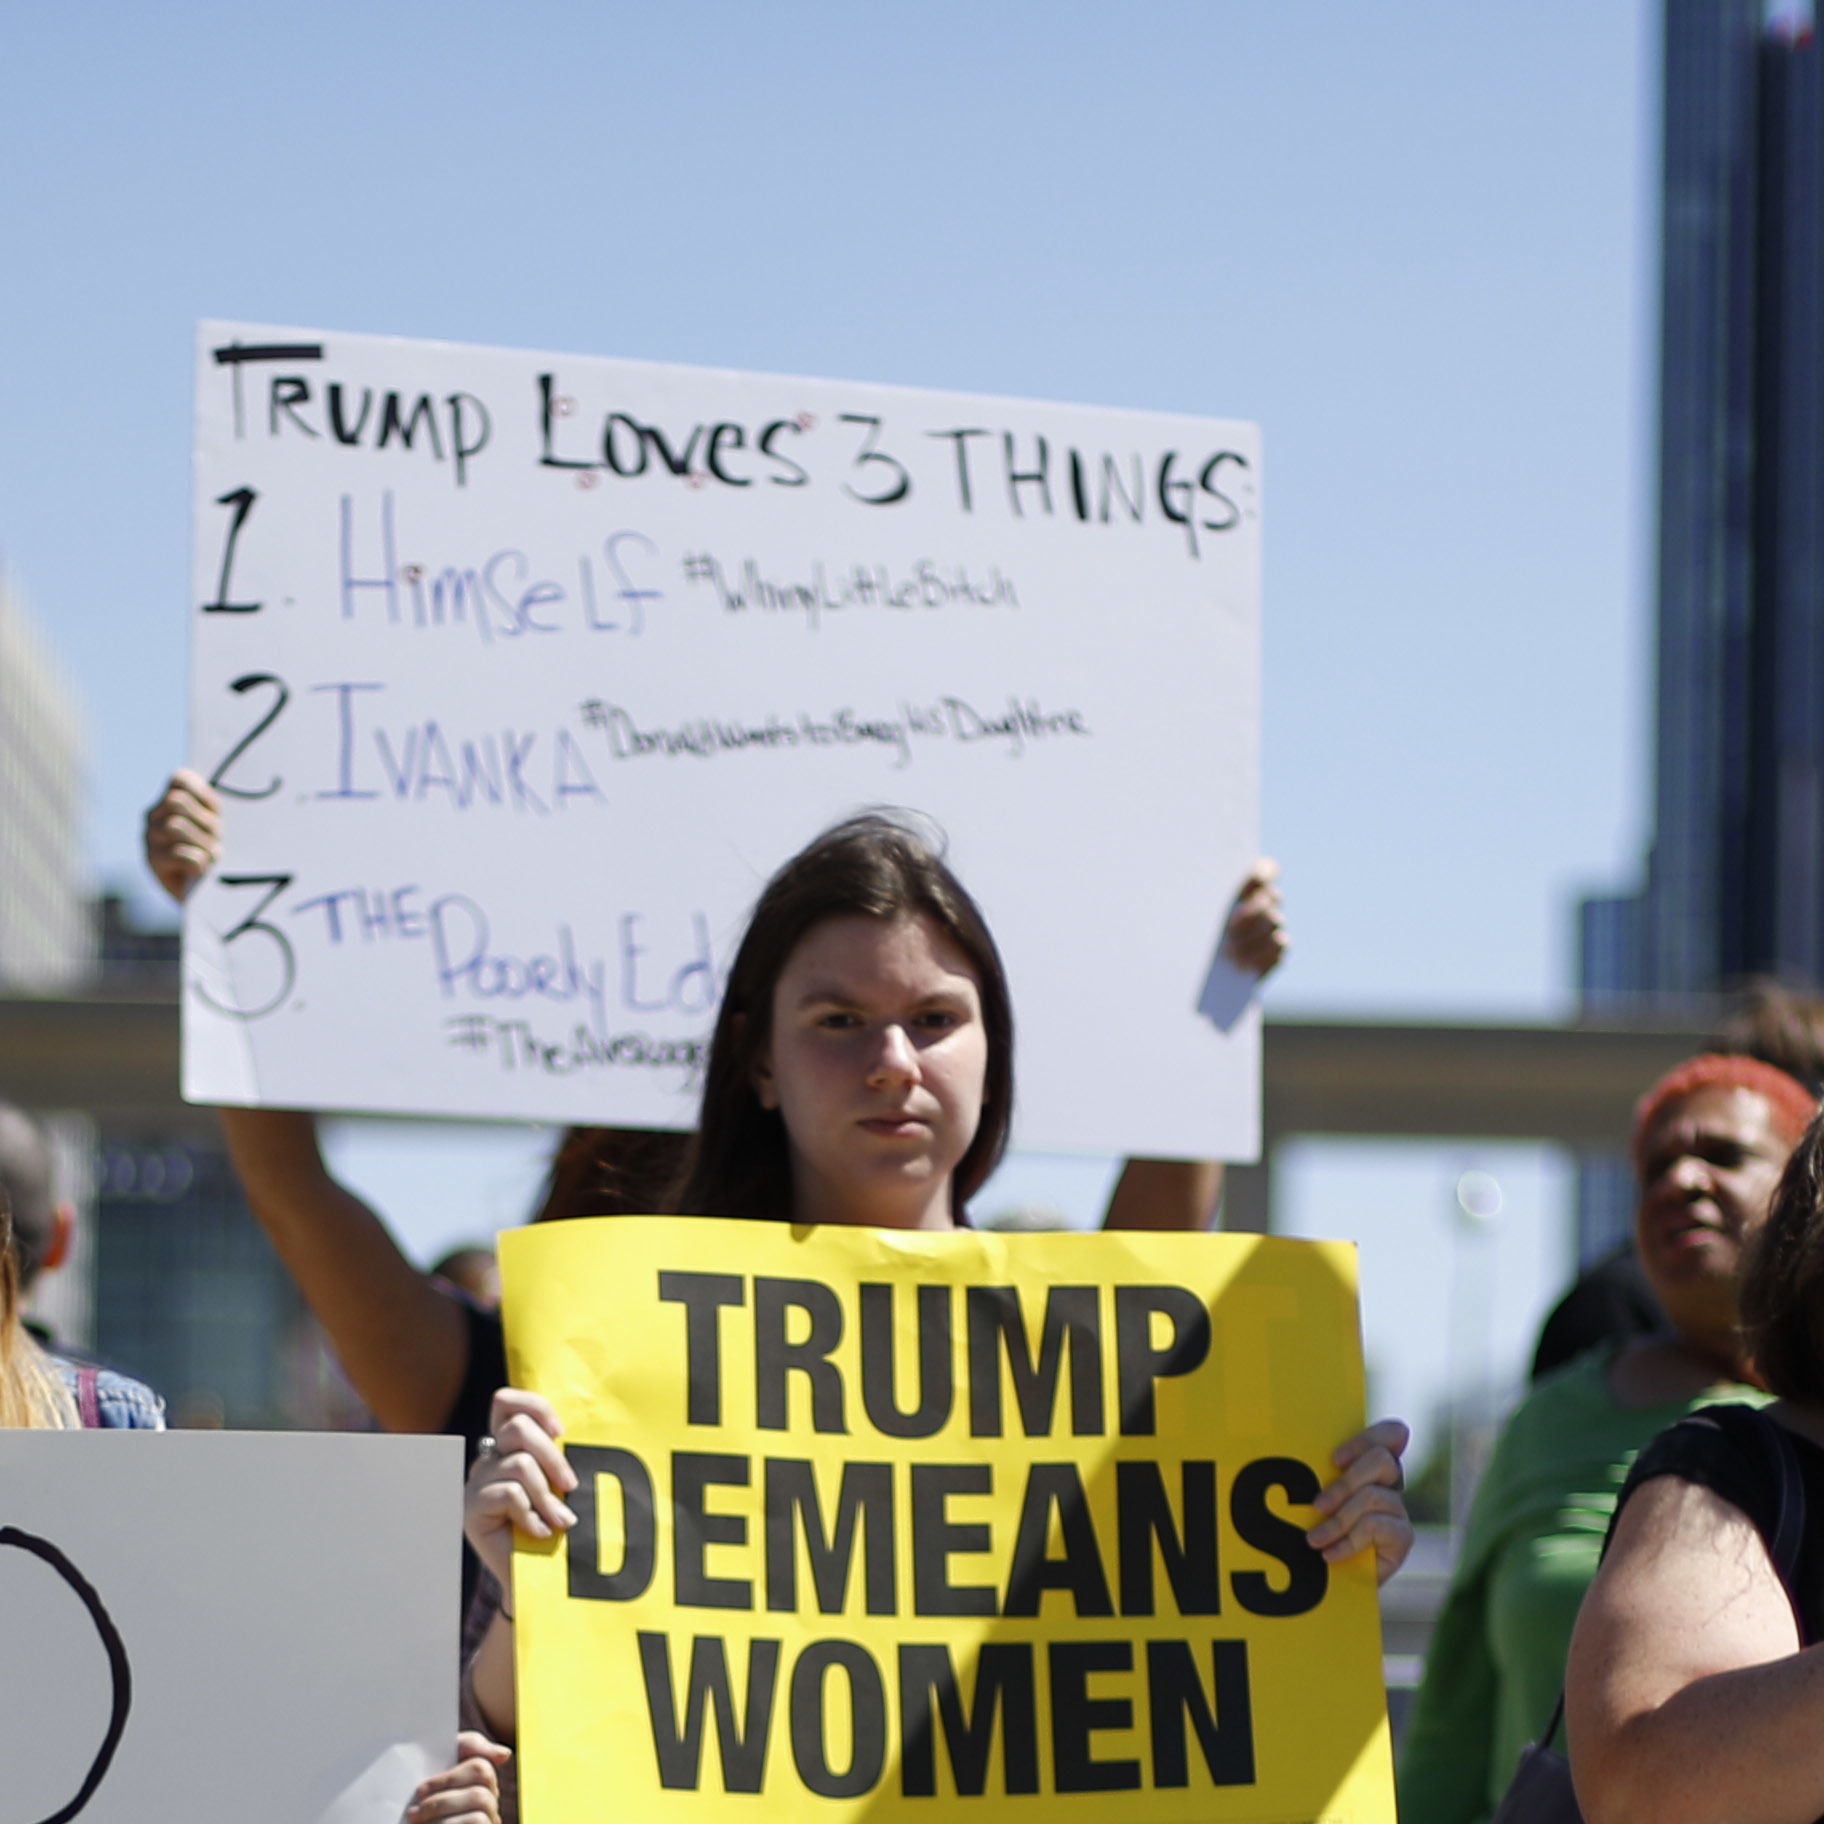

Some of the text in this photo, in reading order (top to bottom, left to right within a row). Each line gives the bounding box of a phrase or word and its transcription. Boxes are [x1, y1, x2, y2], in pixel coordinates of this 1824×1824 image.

[213, 342, 490, 487] TRUMP
[538, 373, 807, 490] Loves
[838, 413, 910, 506] 3
[309, 682, 610, 816] IVANKA
[291, 884, 422, 945] THE
[657, 1269, 1212, 1438] TRUMP
[564, 1442, 1329, 1619] DEMEANS
[636, 1630, 1257, 1800] WOMEN
